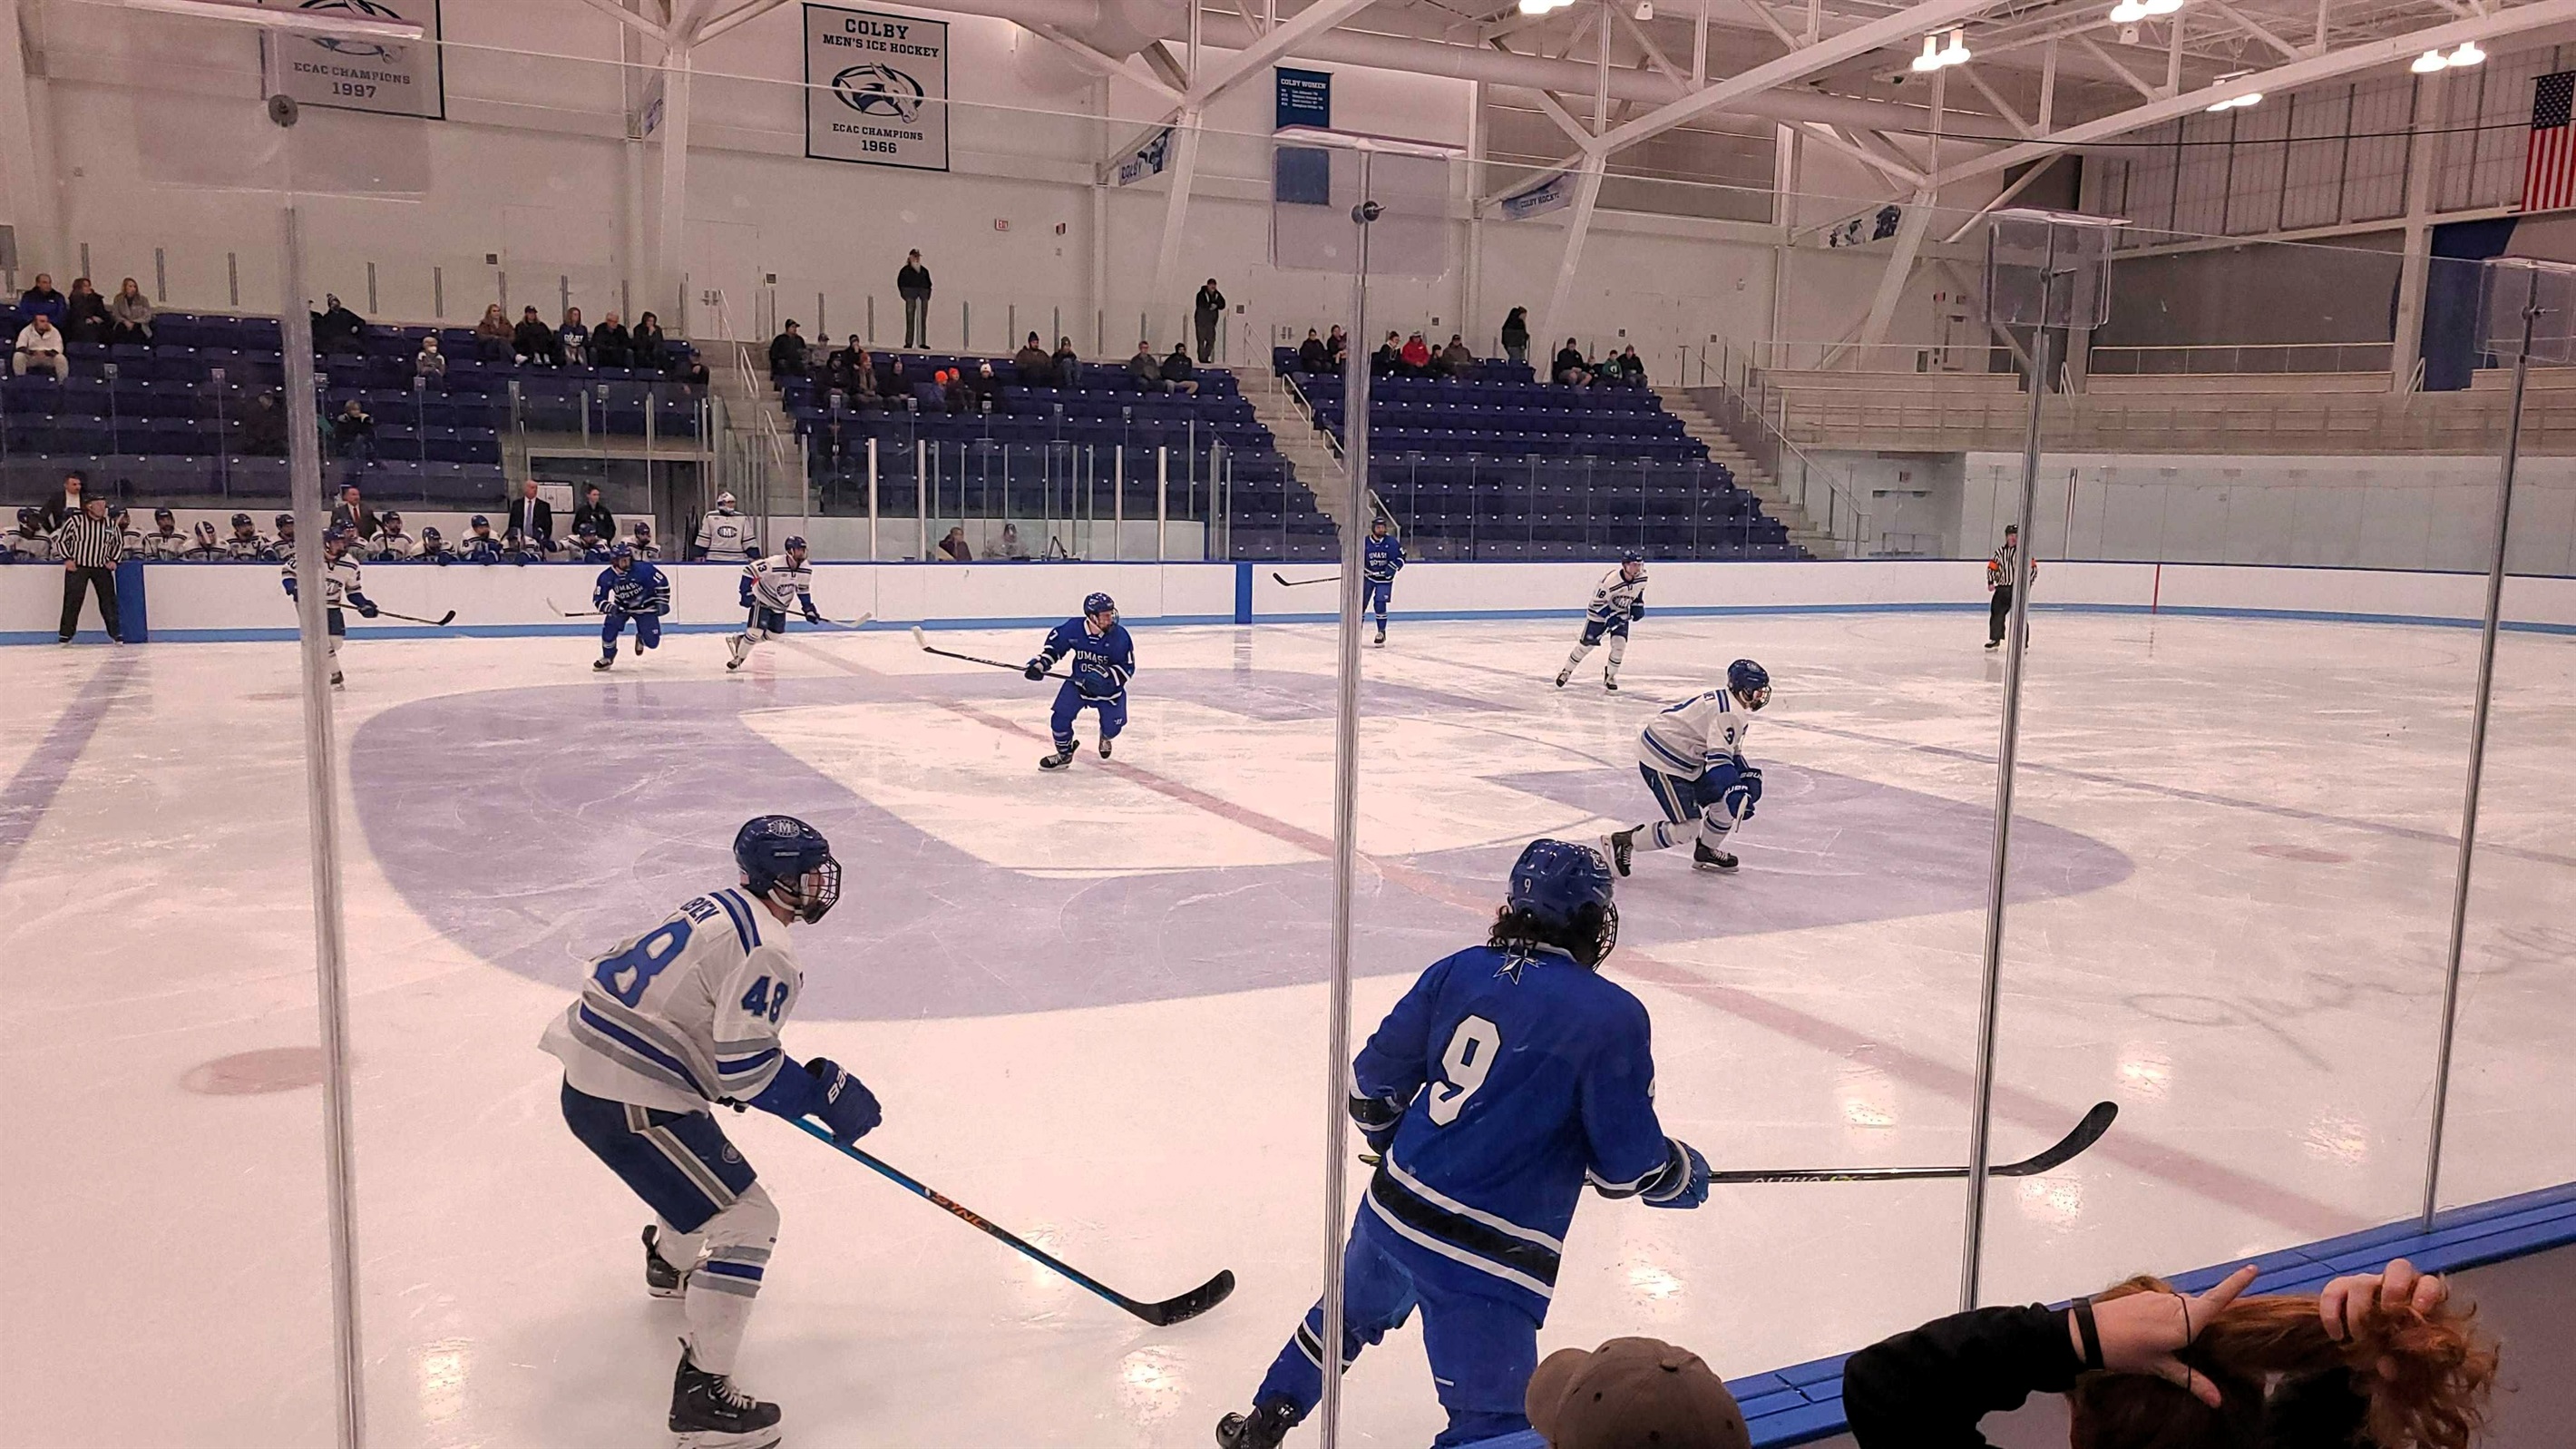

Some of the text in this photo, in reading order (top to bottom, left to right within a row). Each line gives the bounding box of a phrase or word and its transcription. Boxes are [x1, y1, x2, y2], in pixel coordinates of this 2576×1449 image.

[845, 18, 909, 40] COLBY
[823, 34, 939, 57] MEN'S ICE HOCKEY
[294, 62, 411, 84] ECAC CHAMPIONS
[332, 82, 376, 98] 1997
[833, 123, 923, 141] ECAC CHAMPIONS
[861, 140, 897, 153] 1966
[1049, 630, 1059, 641] 7
[1077, 651, 1108, 664] UMASS
[1127, 651, 1133, 664] 1
[1725, 785, 1749, 795] UER
[1525, 878, 1532, 893] 9
[590, 917, 693, 1009] 8
[741, 975, 789, 1023] 48
[1429, 1014, 1501, 1126] 9
